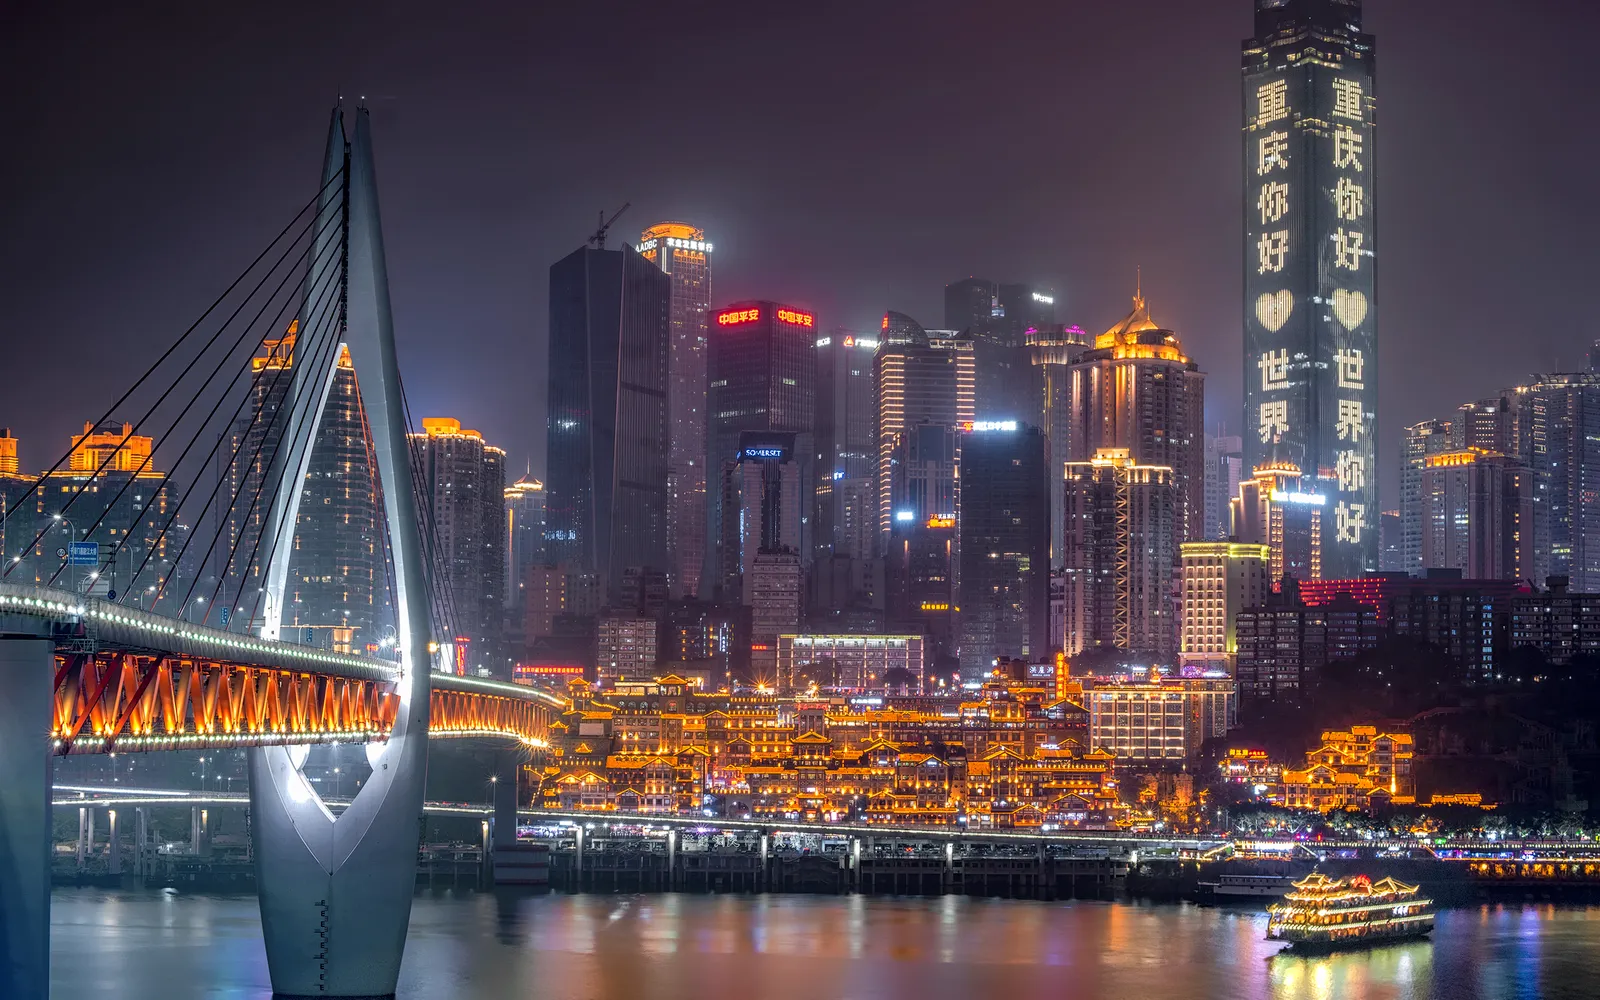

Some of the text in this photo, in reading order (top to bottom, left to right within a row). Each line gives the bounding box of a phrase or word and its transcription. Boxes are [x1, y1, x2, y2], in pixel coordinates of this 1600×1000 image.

[1257, 79, 1288, 274] 重庆你好
[719, 309, 759, 325] 中国平安
[778, 309, 812, 326] 中国平安
[1332, 78, 1365, 544] 重庆你好 世界你好
[745, 449, 782, 457] SOMERSET
